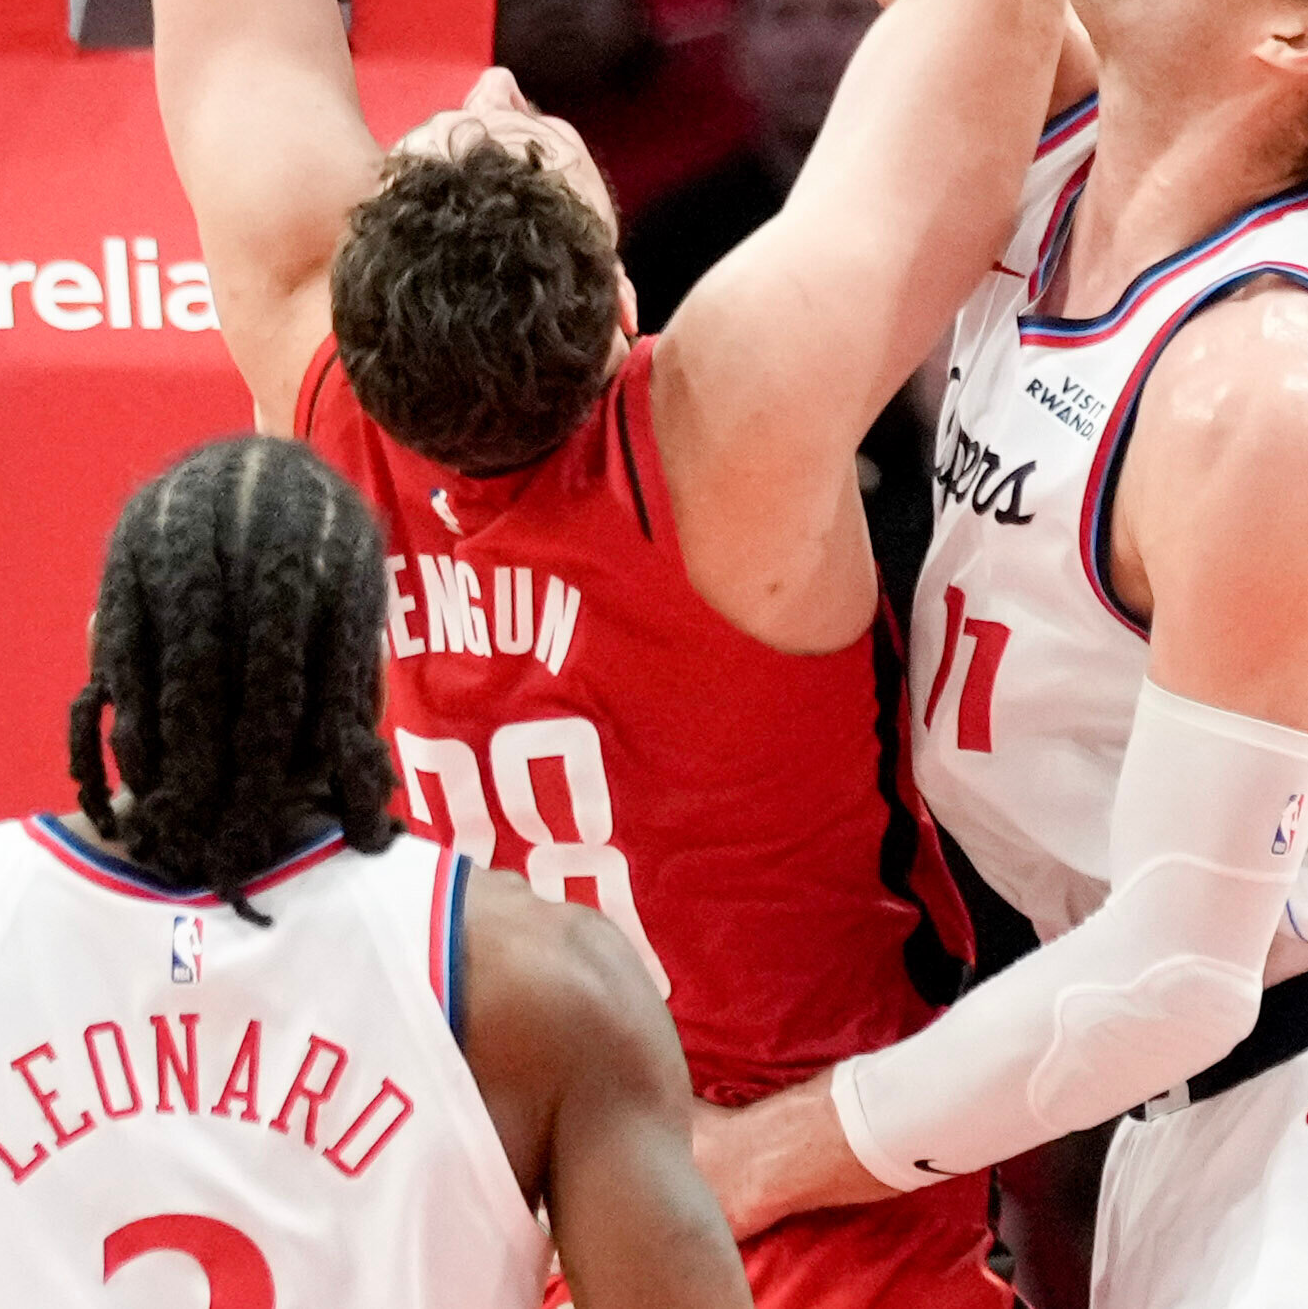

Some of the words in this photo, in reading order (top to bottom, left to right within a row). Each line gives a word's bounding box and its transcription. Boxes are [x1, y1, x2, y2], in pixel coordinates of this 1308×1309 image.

[1025, 378, 1099, 441] RWAND
[1061, 375, 1107, 419] VISIT
[381, 553, 583, 677] ENGUN
